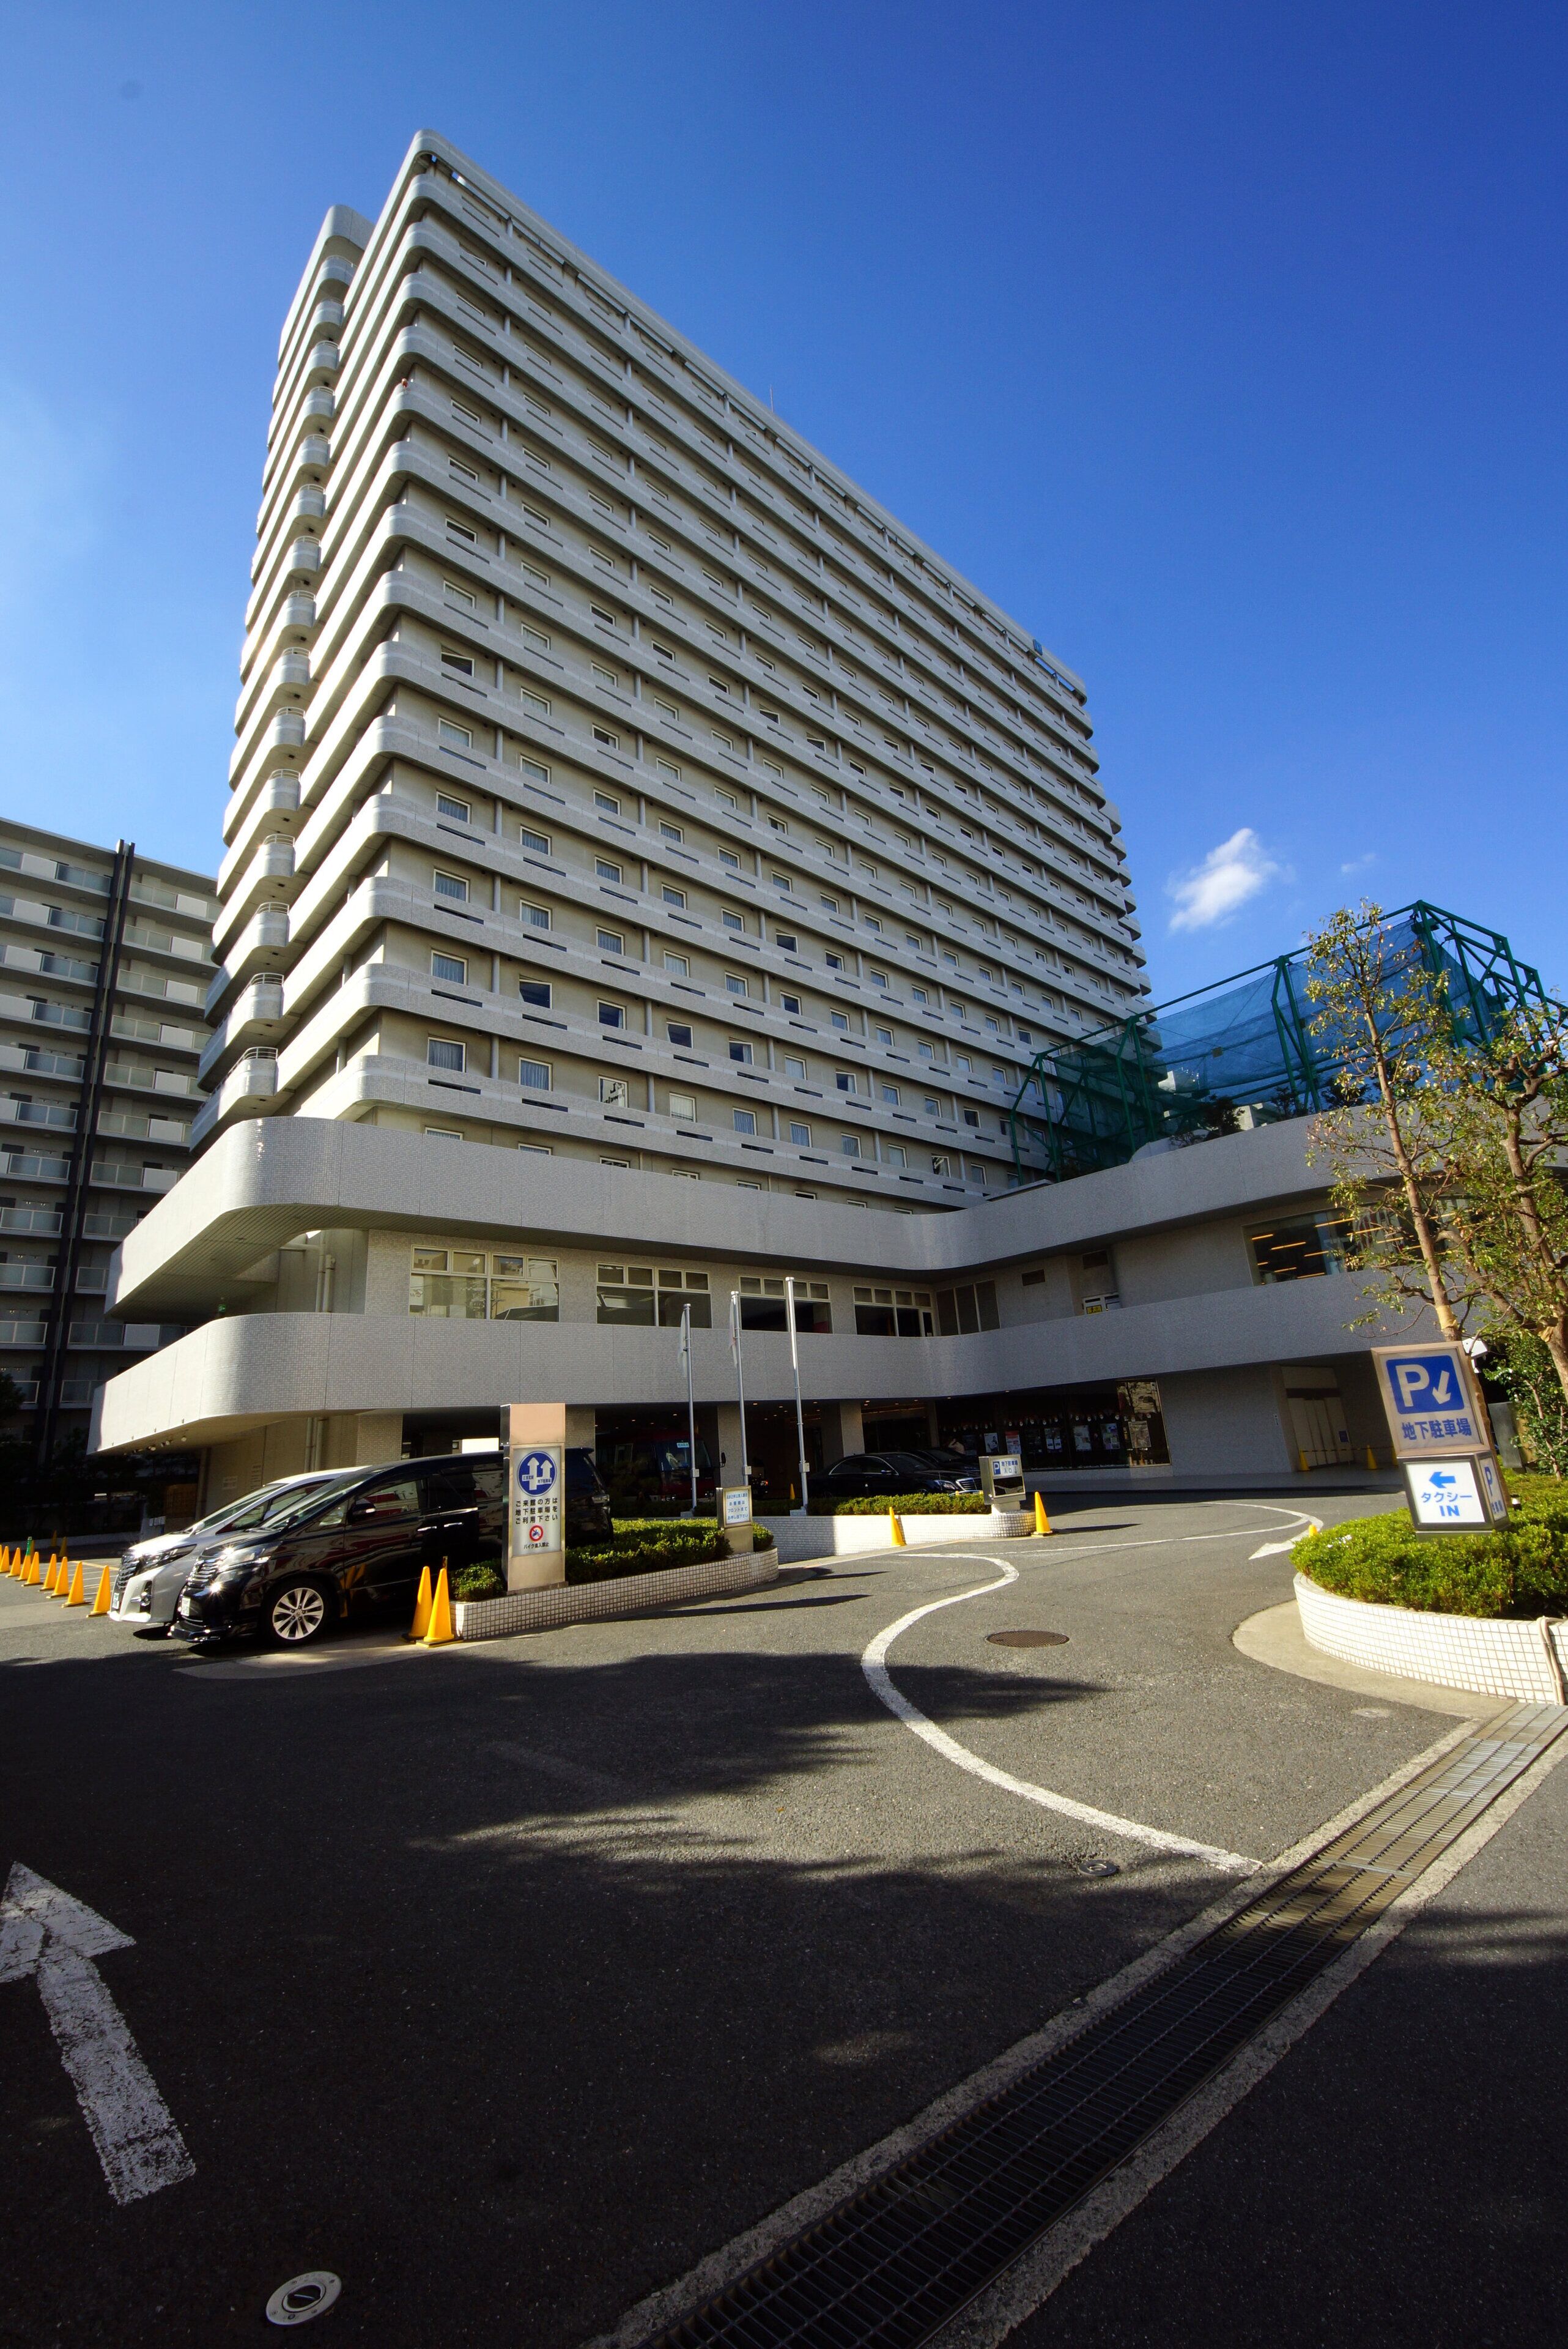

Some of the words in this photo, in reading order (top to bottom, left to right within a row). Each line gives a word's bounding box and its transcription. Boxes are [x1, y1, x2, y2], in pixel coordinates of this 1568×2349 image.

[1396, 1364, 1430, 1407] P
[1402, 1417, 1472, 1440] 地下駐車場
[994, 1463, 999, 1474] P
[1484, 1467, 1493, 1497] P
[516, 1498, 558, 1507] ご来館の方は
[1421, 1493, 1472, 1502] タクシー
[516, 1506, 558, 1516] 地下駐車場を
[1439, 1505, 1460, 1516] IN
[516, 1515, 558, 1524] ご利用下さい
